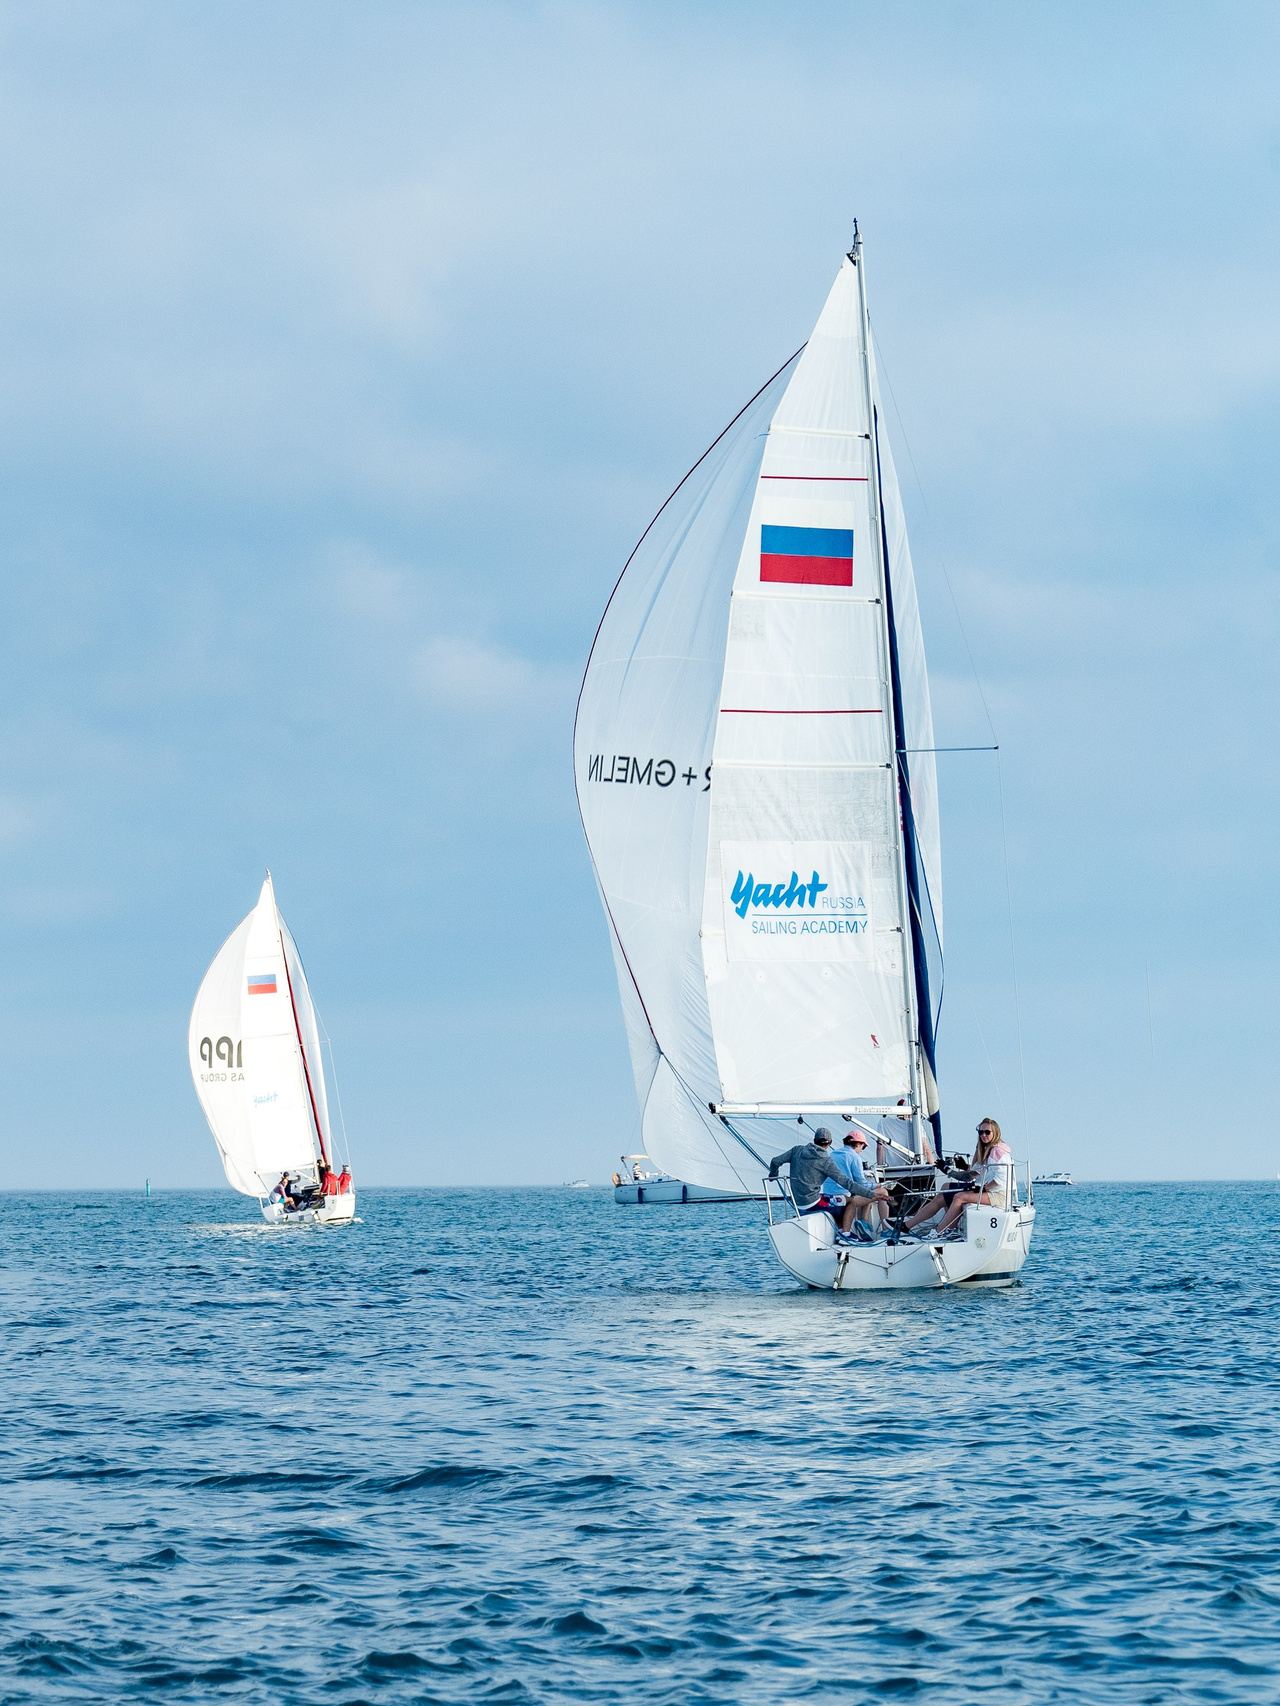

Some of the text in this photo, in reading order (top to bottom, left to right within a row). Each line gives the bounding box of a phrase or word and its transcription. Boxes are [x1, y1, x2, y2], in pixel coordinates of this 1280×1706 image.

[822, 896, 866, 909] RUSSIA
[751, 920, 868, 935] SAILING ACADEMY
[990, 1217, 998, 1229] 8
